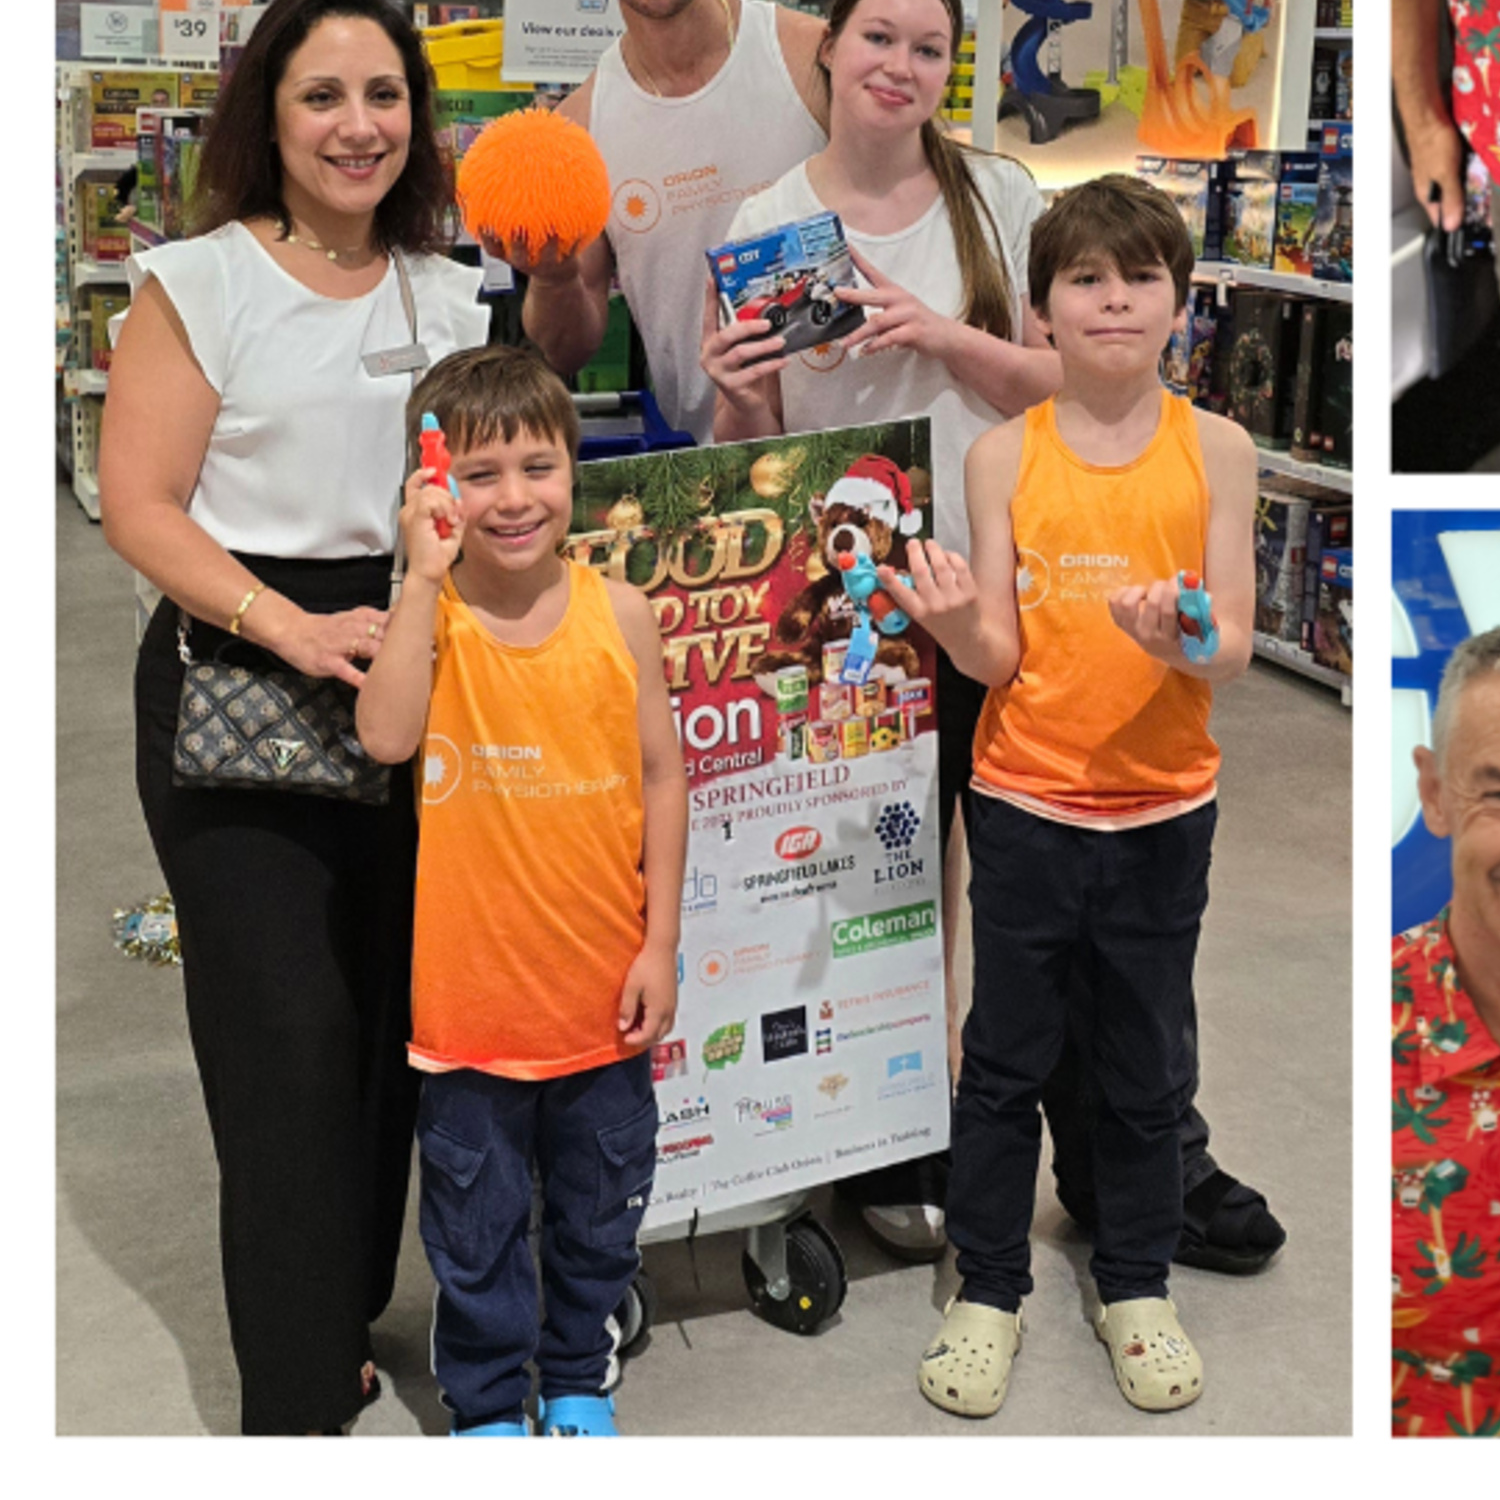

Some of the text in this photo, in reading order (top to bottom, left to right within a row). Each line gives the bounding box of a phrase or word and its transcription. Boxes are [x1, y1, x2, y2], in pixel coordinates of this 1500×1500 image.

[173, 18, 207, 38] $39
[521, 21, 615, 38] View our deals
[662, 164, 719, 188] ORION
[1059, 553, 1129, 569] ORION
[688, 580, 770, 630] TOY
[471, 743, 543, 761] ORION
[700, 746, 763, 776] Central
[692, 764, 850, 813] SPRINGFIELD
[738, 800, 802, 823] PROUDLY
[804, 782, 889, 809] SPONSORED
[890, 778, 909, 794] BY
[780, 830, 819, 854] IGA
[885, 848, 913, 864] THE
[743, 863, 818, 892] SPRINGFIELD
[819, 855, 856, 874] LAKES
[874, 858, 924, 885] LION
[832, 906, 936, 947] Coleman
